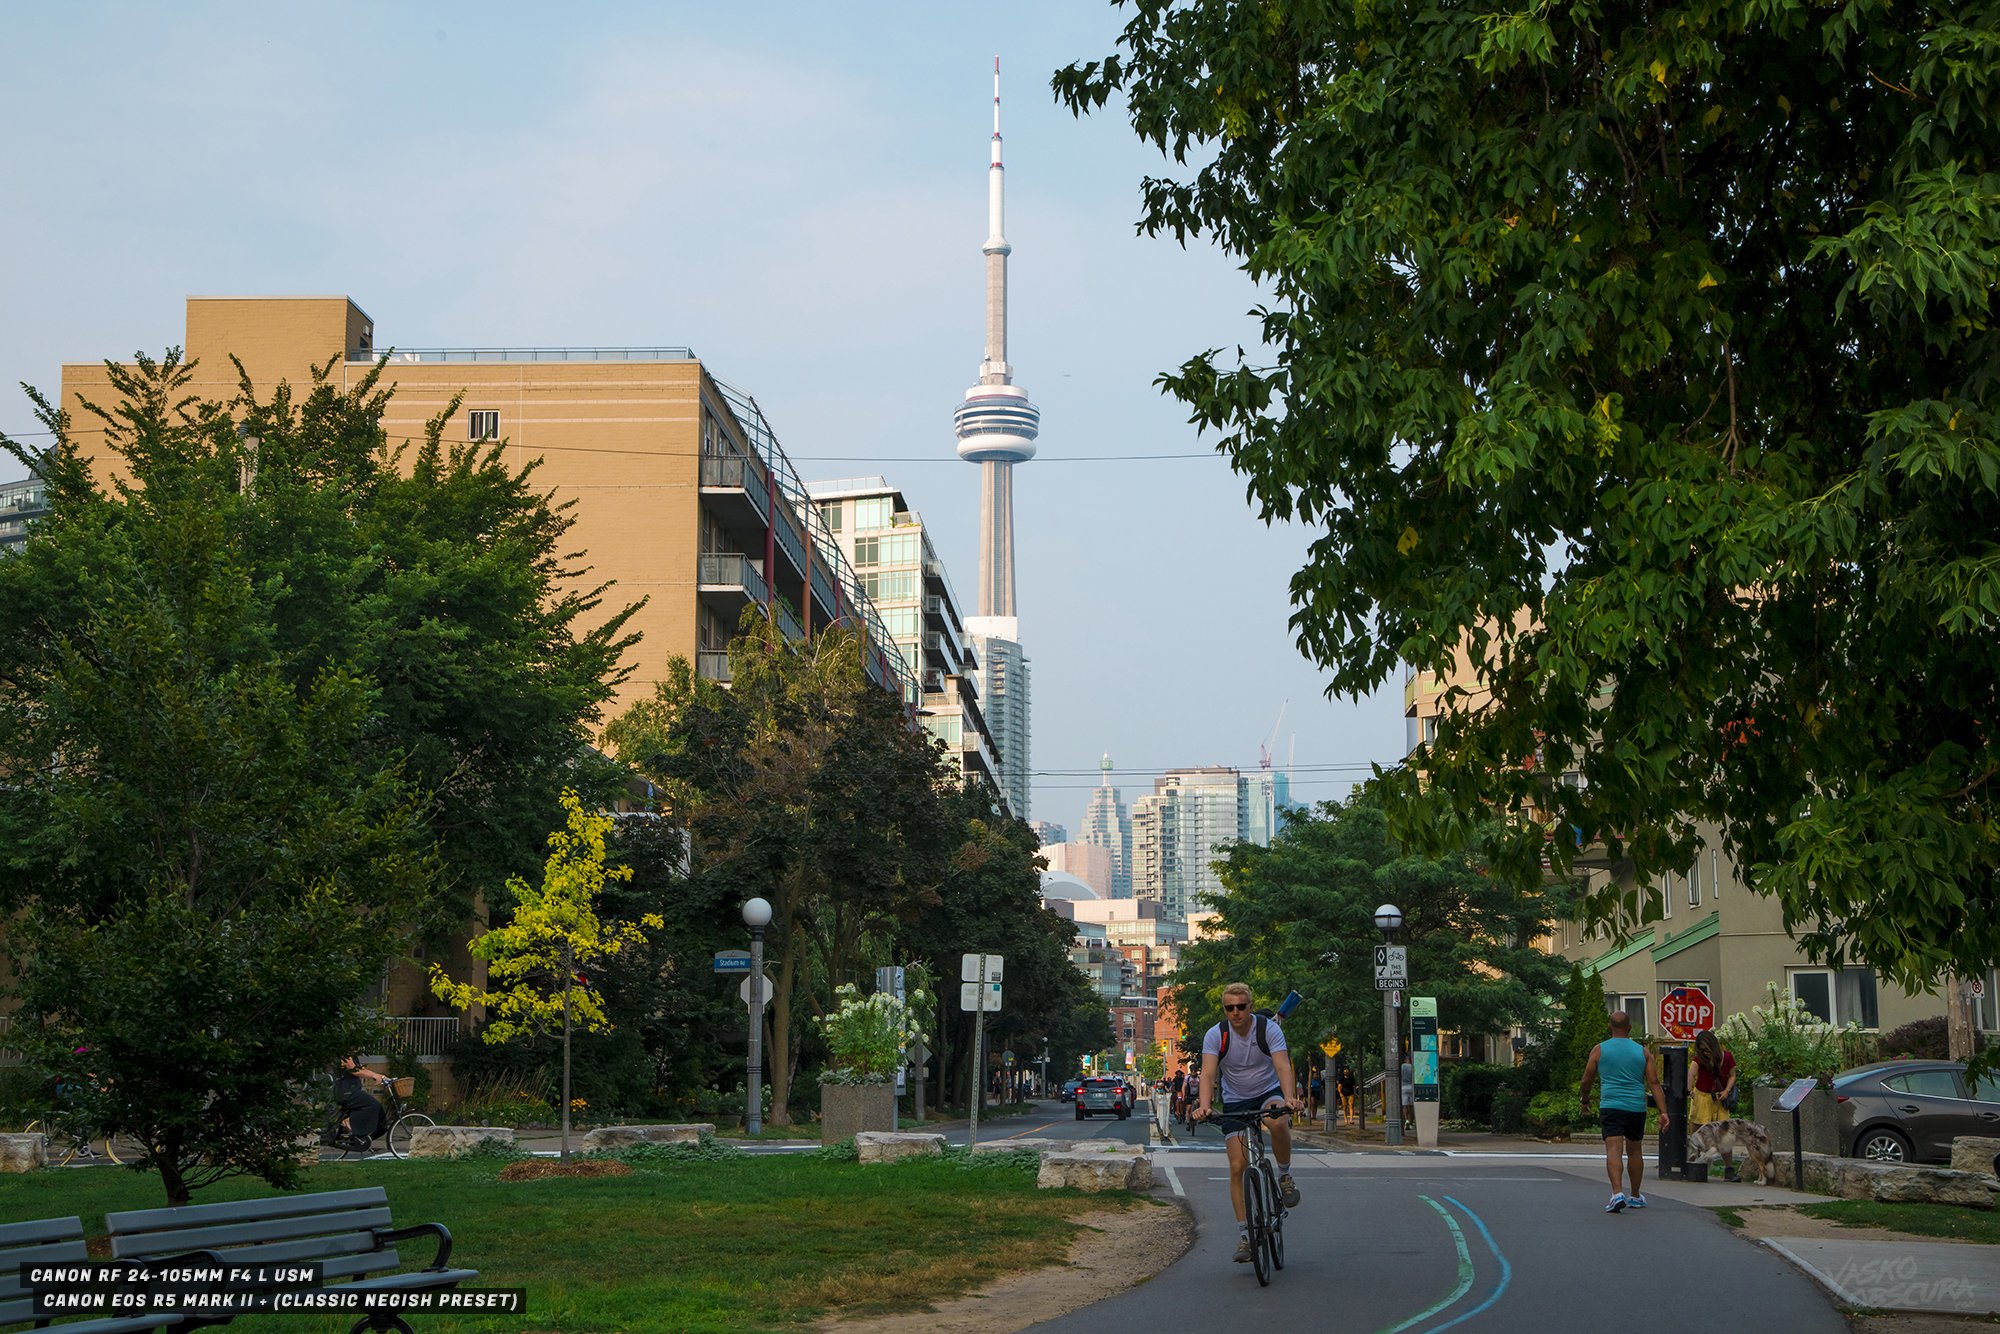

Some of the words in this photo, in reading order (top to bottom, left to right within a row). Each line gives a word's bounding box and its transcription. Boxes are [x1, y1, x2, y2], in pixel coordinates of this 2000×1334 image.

[720, 959, 739, 967] Stadium
[1379, 979, 1405, 988] BEGINS
[1663, 1003, 1711, 1025] STOP
